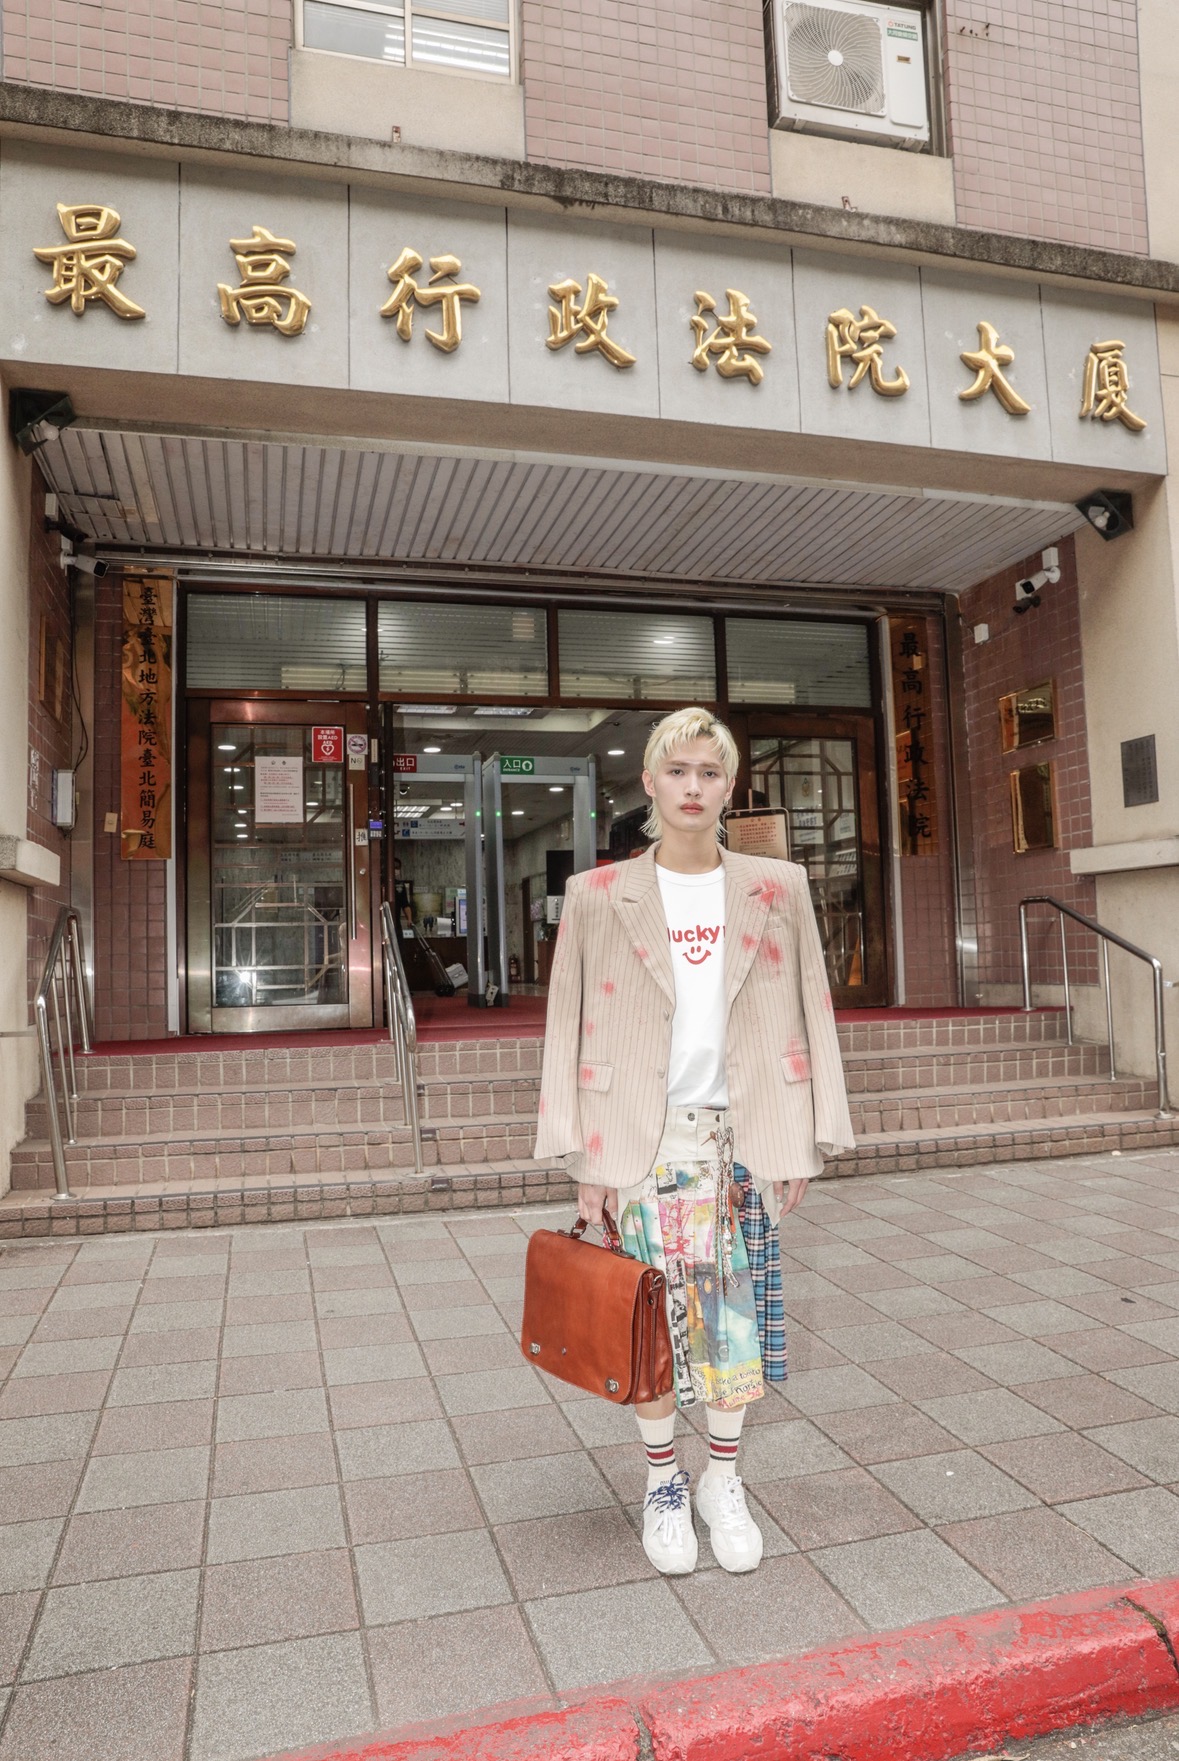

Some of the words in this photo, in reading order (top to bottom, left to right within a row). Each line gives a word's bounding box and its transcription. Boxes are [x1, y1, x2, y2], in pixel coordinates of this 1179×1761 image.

[138, 586, 158, 850] 臺灣臺北地方法院臺北簡易庭
[396, 757, 415, 767] 出口
[503, 759, 521, 768] 入口
[900, 632, 932, 838] 最高行政法院
